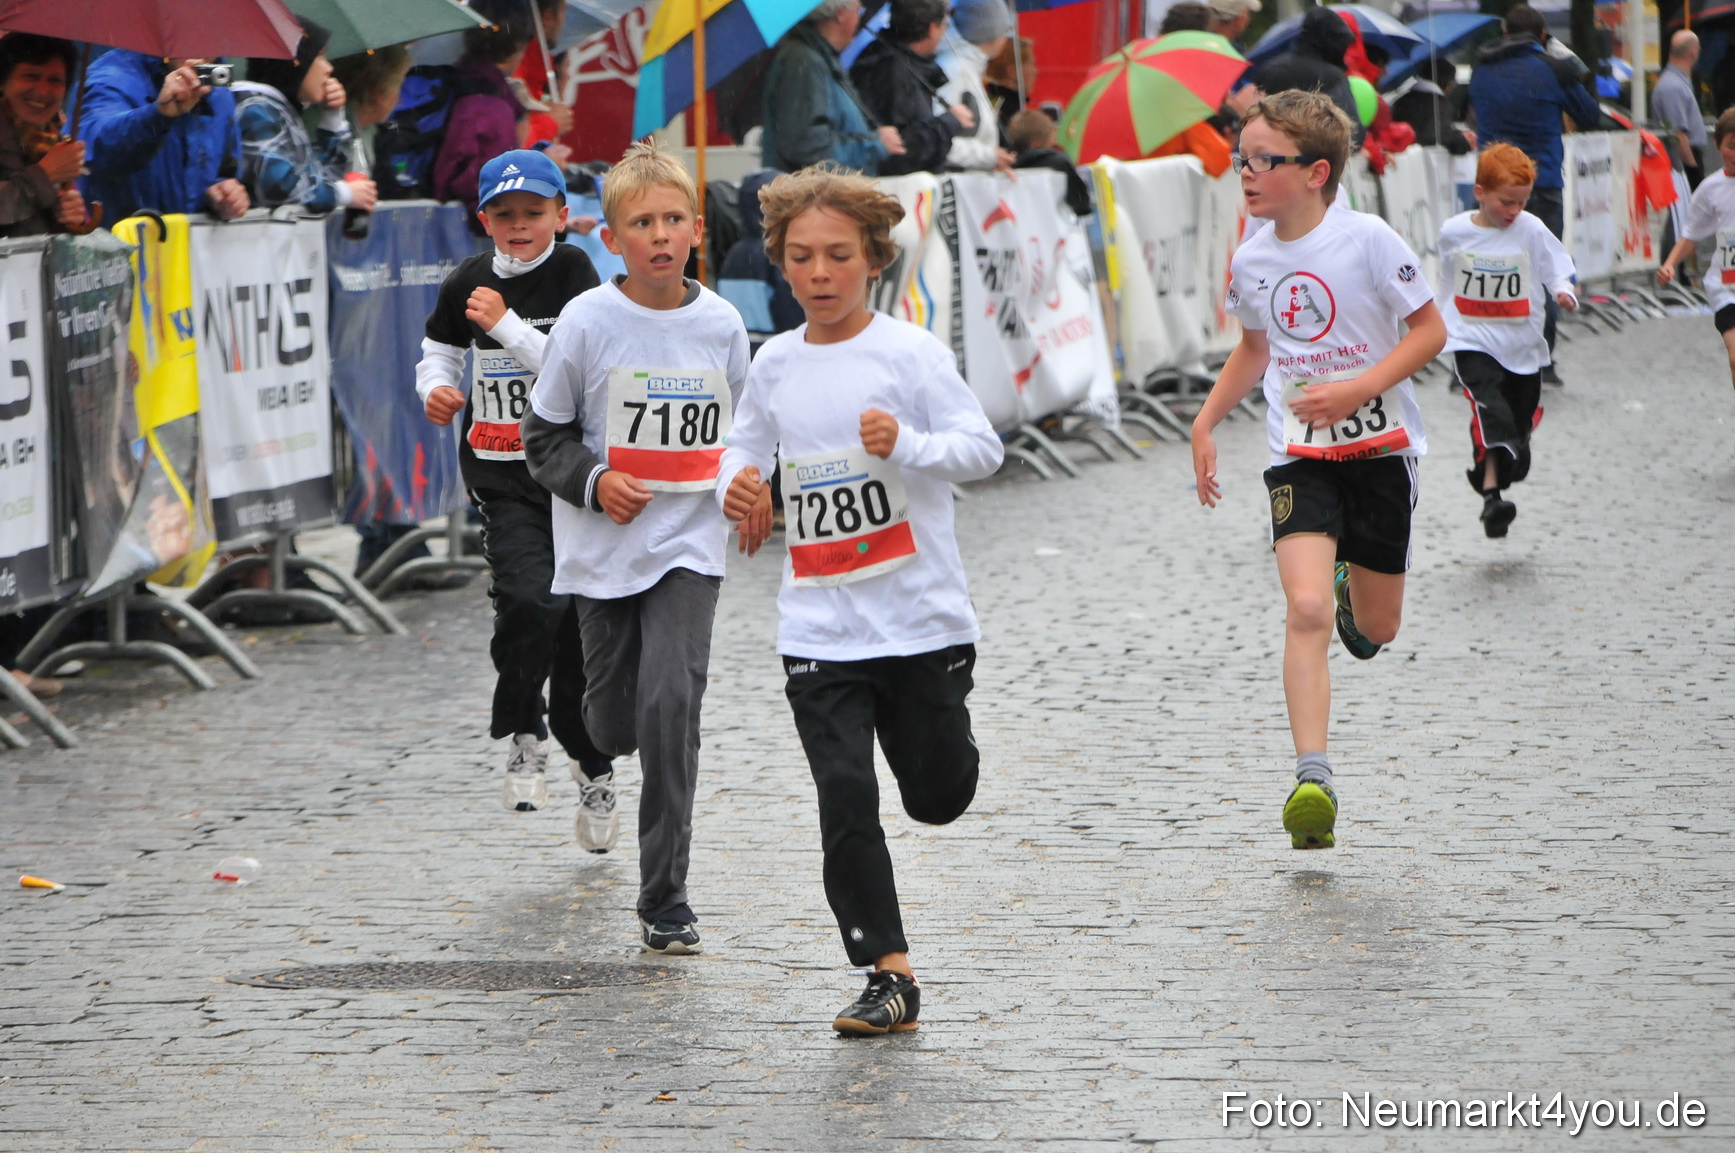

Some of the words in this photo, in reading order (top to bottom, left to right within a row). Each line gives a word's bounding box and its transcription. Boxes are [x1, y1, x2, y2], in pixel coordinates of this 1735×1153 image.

[1461, 269, 1521, 298] 7170
[1310, 350, 1333, 364] MIT
[647, 377, 704, 391] BOCK
[477, 379, 538, 420] 718
[623, 401, 720, 446] 7180
[474, 424, 525, 452] Hanne
[796, 459, 850, 481] BOCK
[790, 480, 892, 539] 7280
